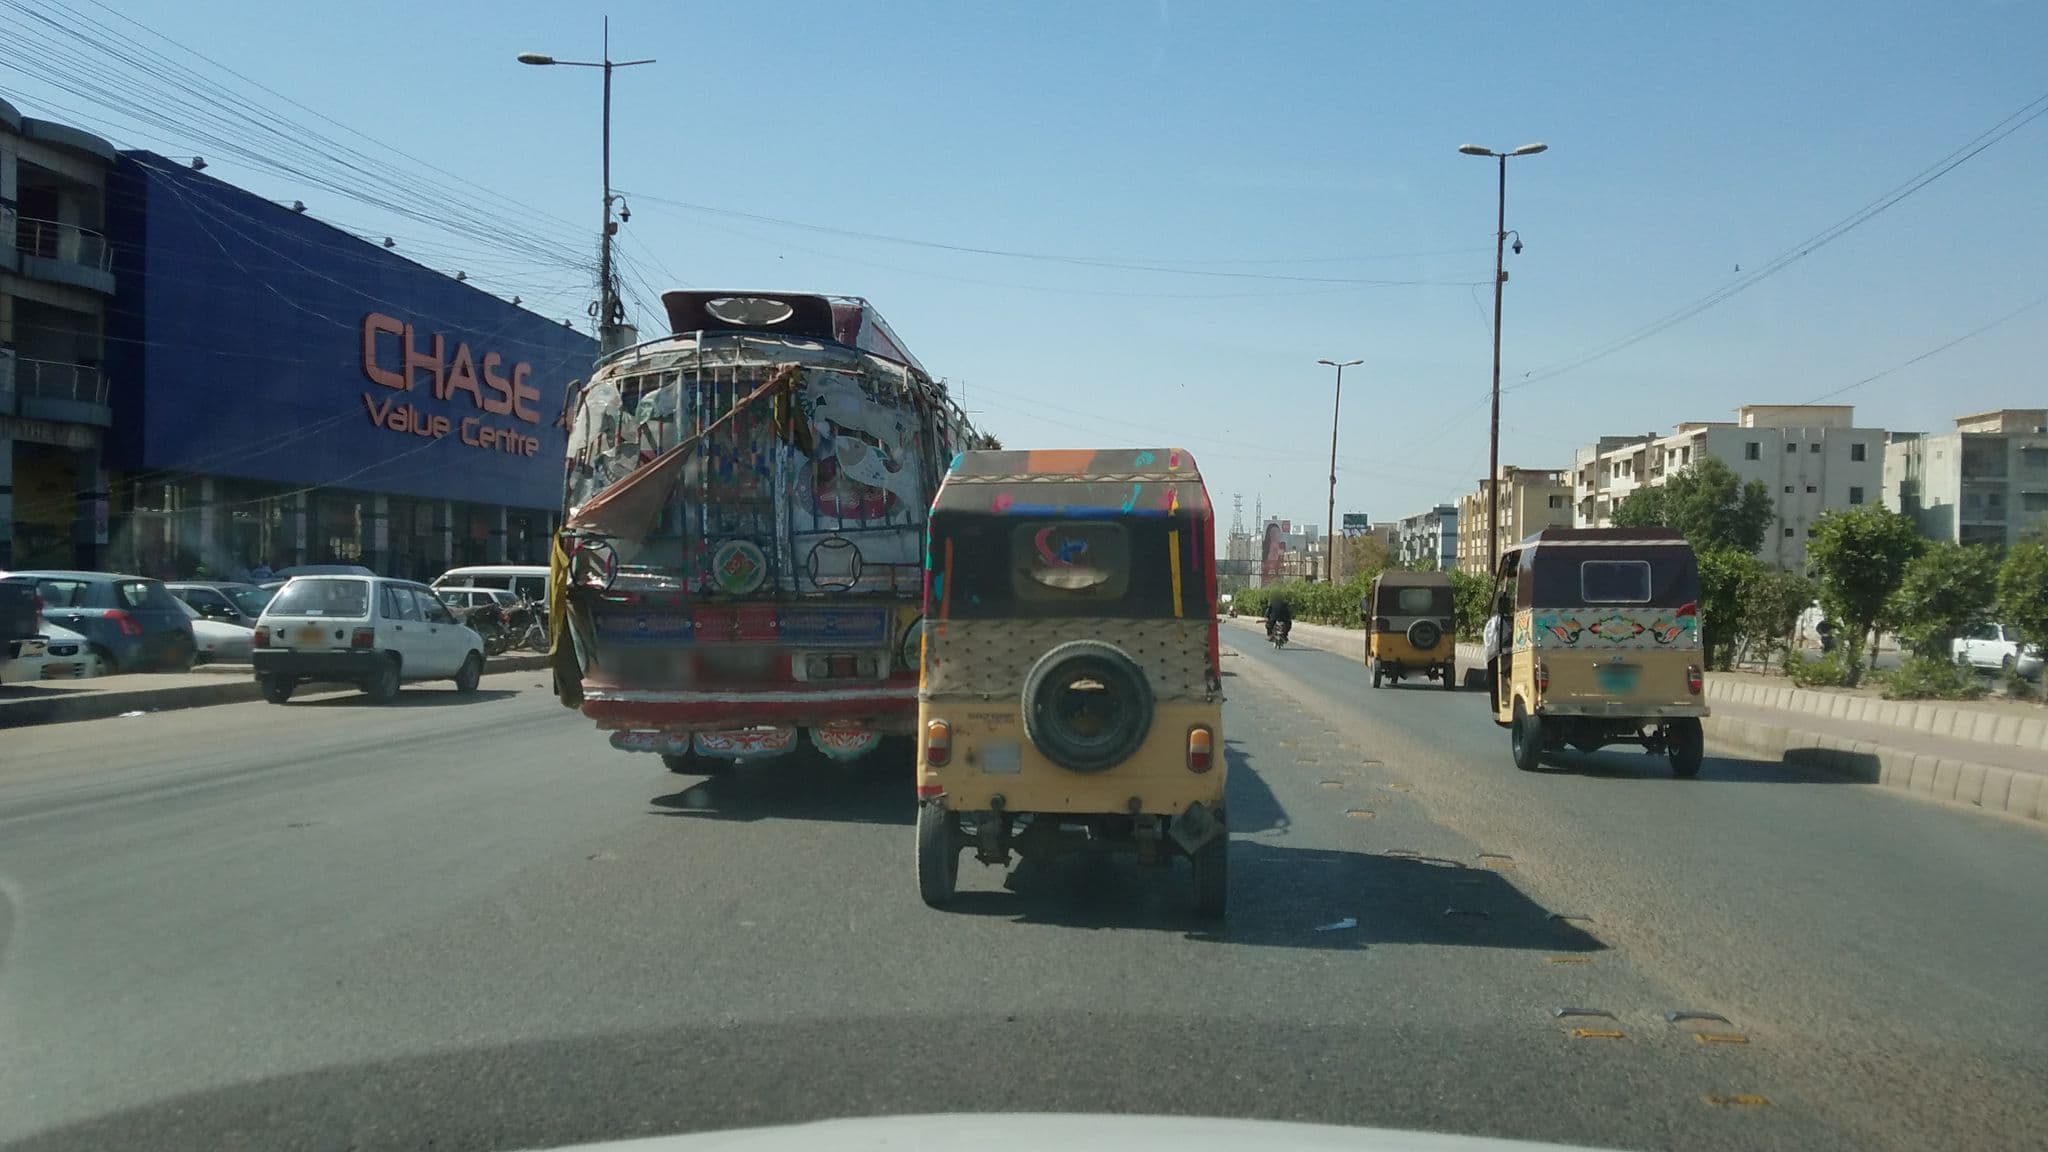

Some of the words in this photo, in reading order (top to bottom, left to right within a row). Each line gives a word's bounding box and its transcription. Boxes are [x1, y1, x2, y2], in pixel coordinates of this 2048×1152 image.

[364, 312, 540, 424] CHASE
[364, 392, 450, 439] Value
[460, 416, 540, 457] Centre
